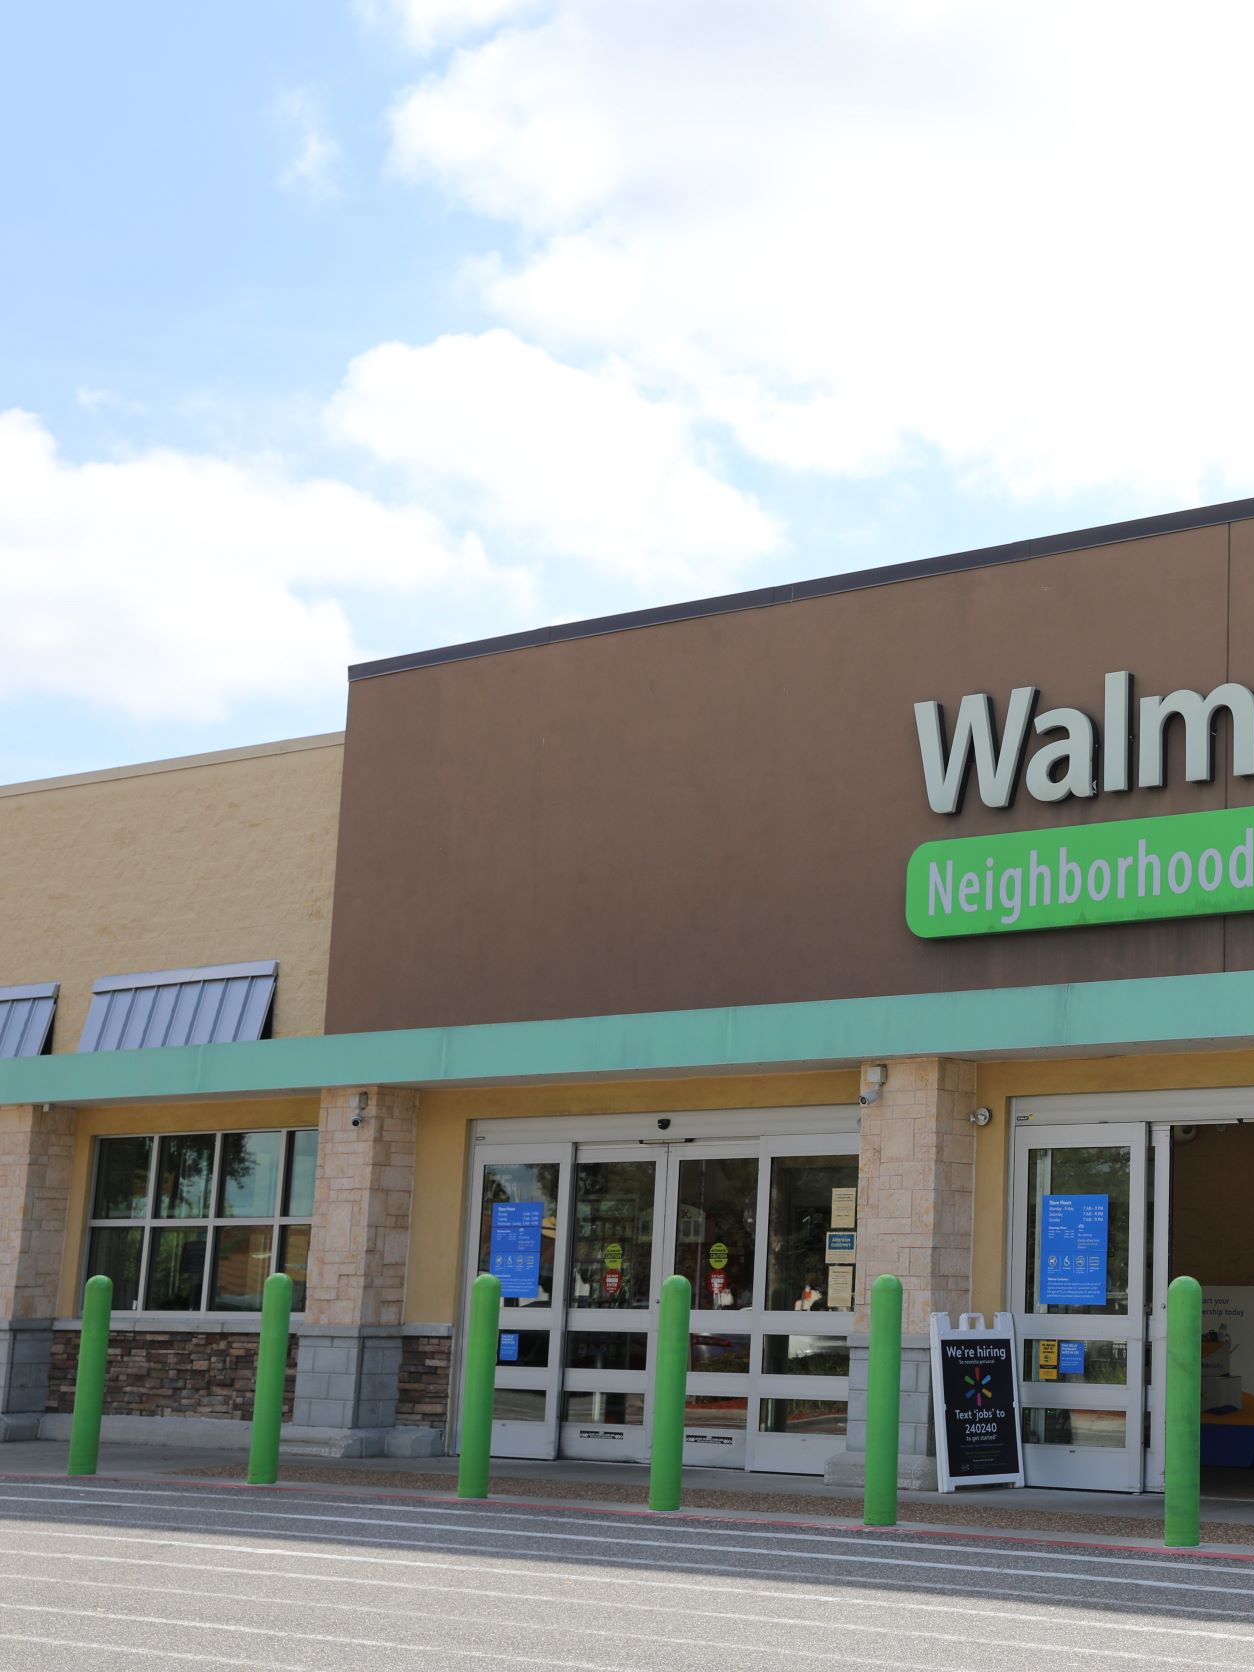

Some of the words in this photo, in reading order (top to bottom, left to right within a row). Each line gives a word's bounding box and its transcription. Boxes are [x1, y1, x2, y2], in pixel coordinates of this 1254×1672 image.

[927, 826, 1254, 924] Neighborhood
[1214, 1298, 1231, 1306] your
[1225, 1308, 1245, 1317] today
[946, 1346, 975, 1358] We're
[977, 1345, 1006, 1360] hiring
[955, 1410, 972, 1420] Text
[996, 1409, 1005, 1418] to
[965, 1423, 997, 1434] 240240
